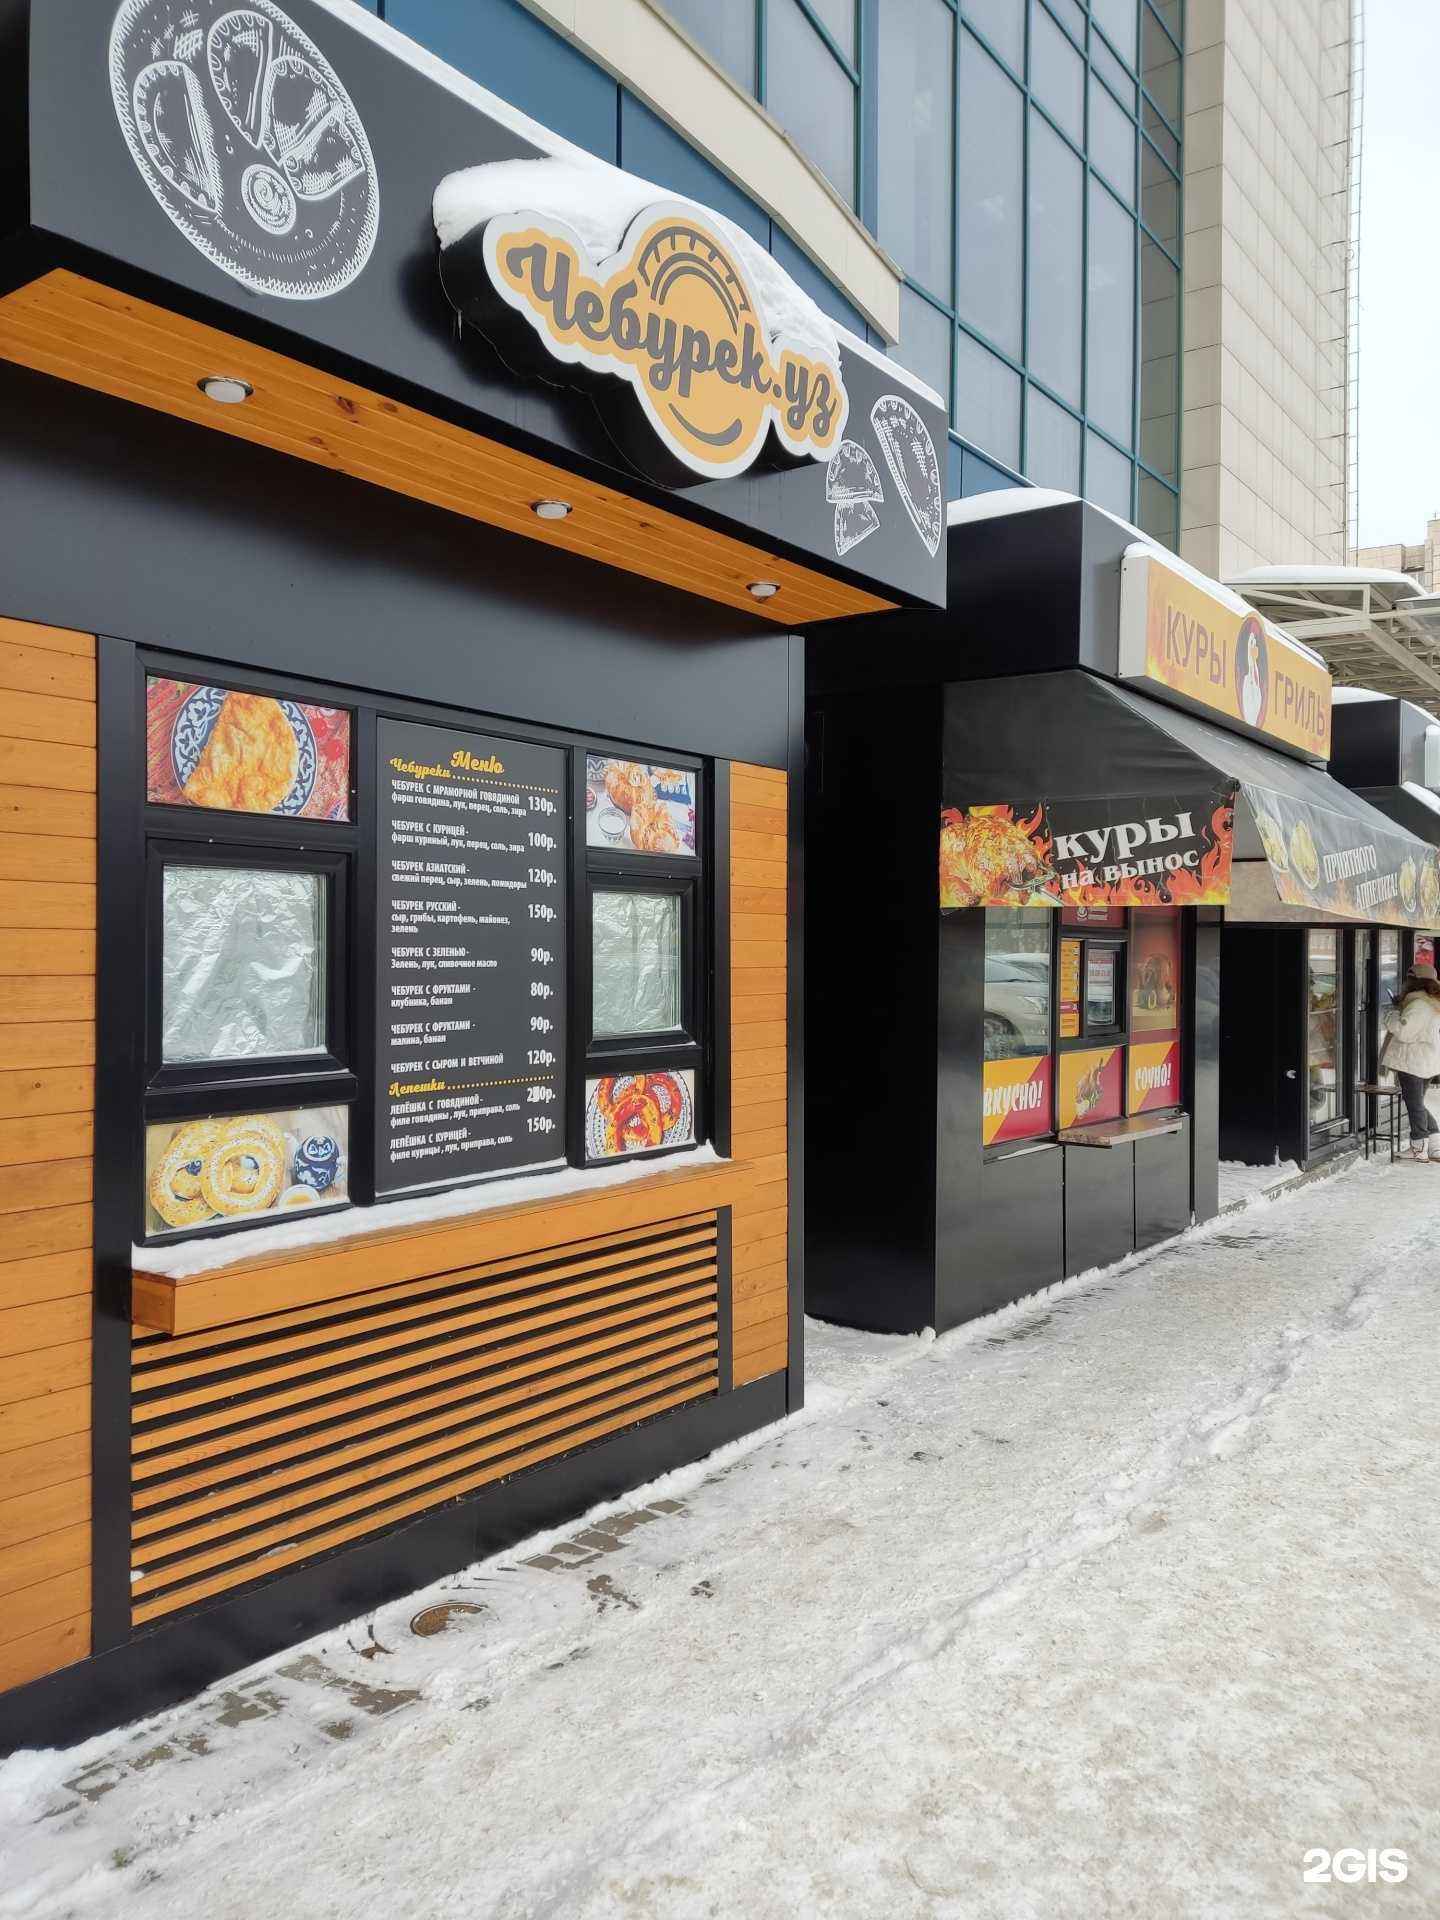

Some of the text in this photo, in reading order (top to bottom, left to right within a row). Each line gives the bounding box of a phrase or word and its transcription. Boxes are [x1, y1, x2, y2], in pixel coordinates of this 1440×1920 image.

[505, 242, 837, 438] Чебурек.уз
[1166, 605, 1328, 737] КУРЫ ГРИЛЬ
[390, 757, 451, 779] Чебуреки
[451, 751, 504, 774] Меню
[391, 779, 520, 805] ЧЕБУРЕК С МРАМОРНОЙ ГОВЯДИНОЙ
[391, 791, 414, 804] фарш
[528, 795, 557, 816] 130р.
[391, 820, 424, 832] ЧЕБУРЕК
[426, 823, 431, 833] С
[391, 831, 414, 844] фарш
[528, 832, 557, 852] 100р.
[391, 860, 424, 872] ЧЕБУРЕК
[1061, 850, 1200, 890] на вынос
[1323, 844, 1377, 884] ПРИЯТНОГО
[528, 868, 557, 888] 120р.
[391, 900, 424, 911] ЧЕБУРЕК
[528, 903, 557, 922] 150р.
[391, 925, 419, 933] зелень
[391, 947, 423, 958] ЧЕБУРЕК
[426, 947, 431, 957] С
[530, 947, 554, 966] 90р.
[391, 985, 423, 996] ЧЕБУРЕК
[425, 984, 431, 995] С
[432, 983, 471, 995] ФРУКТАМИ
[530, 982, 554, 1000] 80р.
[430, 995, 453, 1006] банан
[391, 1022, 423, 1035] ЧЕБУРЕК
[425, 1022, 431, 1033] С
[432, 1020, 471, 1032] ФРУКТАМИ
[530, 1016, 554, 1034] 90р.
[423, 1033, 447, 1044] банан
[391, 1053, 504, 1073] ЧЕБУРЕК С СЫРОМ И ВЕТЧИНОЙ
[527, 1049, 556, 1067] 120р.
[1134, 1063, 1172, 1092] СОЧНО!
[389, 1078, 446, 1098] Лепешки
[505, 1103, 521, 1112] соль
[982, 1080, 1044, 1117] ВКУСНО!
[390, 1101, 426, 1115] ЛЕПЁШКА
[428, 1101, 434, 1110] С
[527, 1116, 555, 1134] 150р.
[390, 1134, 426, 1149] ЛЕПЁШКА
[428, 1133, 434, 1143] С
[497, 1136, 513, 1144] соль
